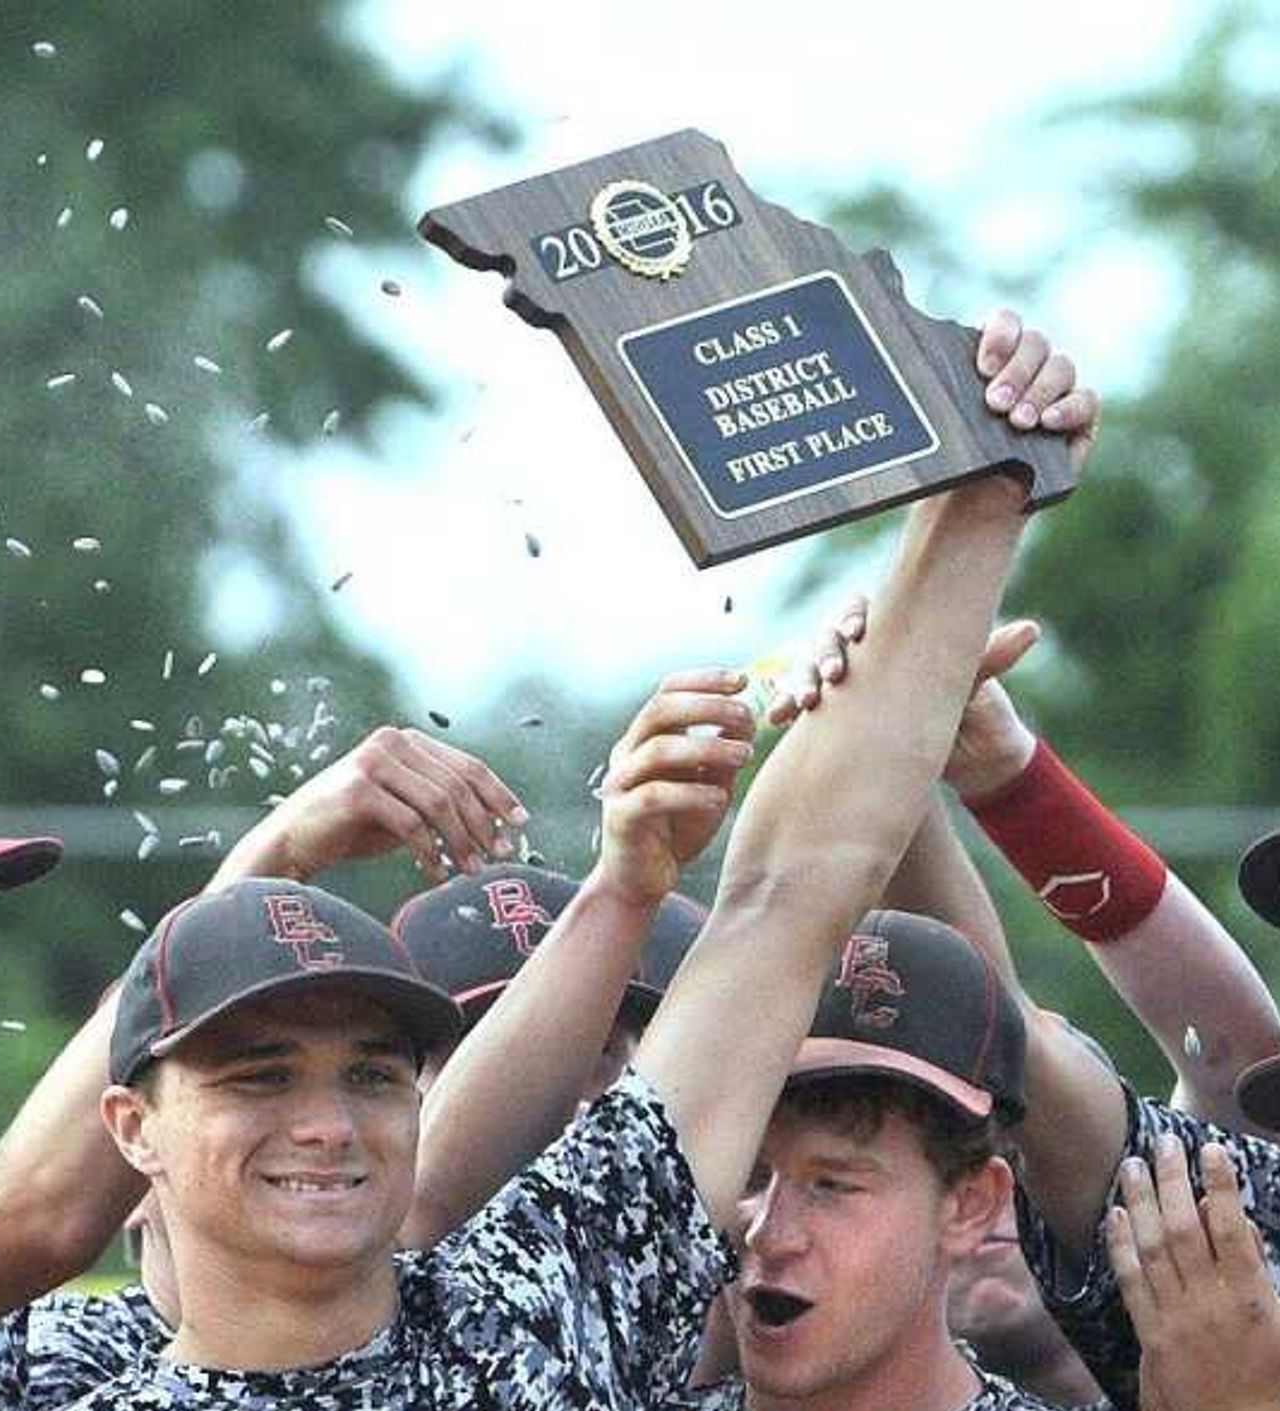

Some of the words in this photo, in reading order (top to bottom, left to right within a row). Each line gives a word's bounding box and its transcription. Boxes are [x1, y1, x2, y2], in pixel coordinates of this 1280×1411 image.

[694, 320, 781, 365] CLASS
[783, 314, 803, 339] 1
[704, 350, 834, 412] DISTRICT
[713, 377, 859, 439] BASEBALL
[726, 441, 805, 485] FIRST
[805, 412, 895, 459] PLACE
[264, 894, 345, 970] BC
